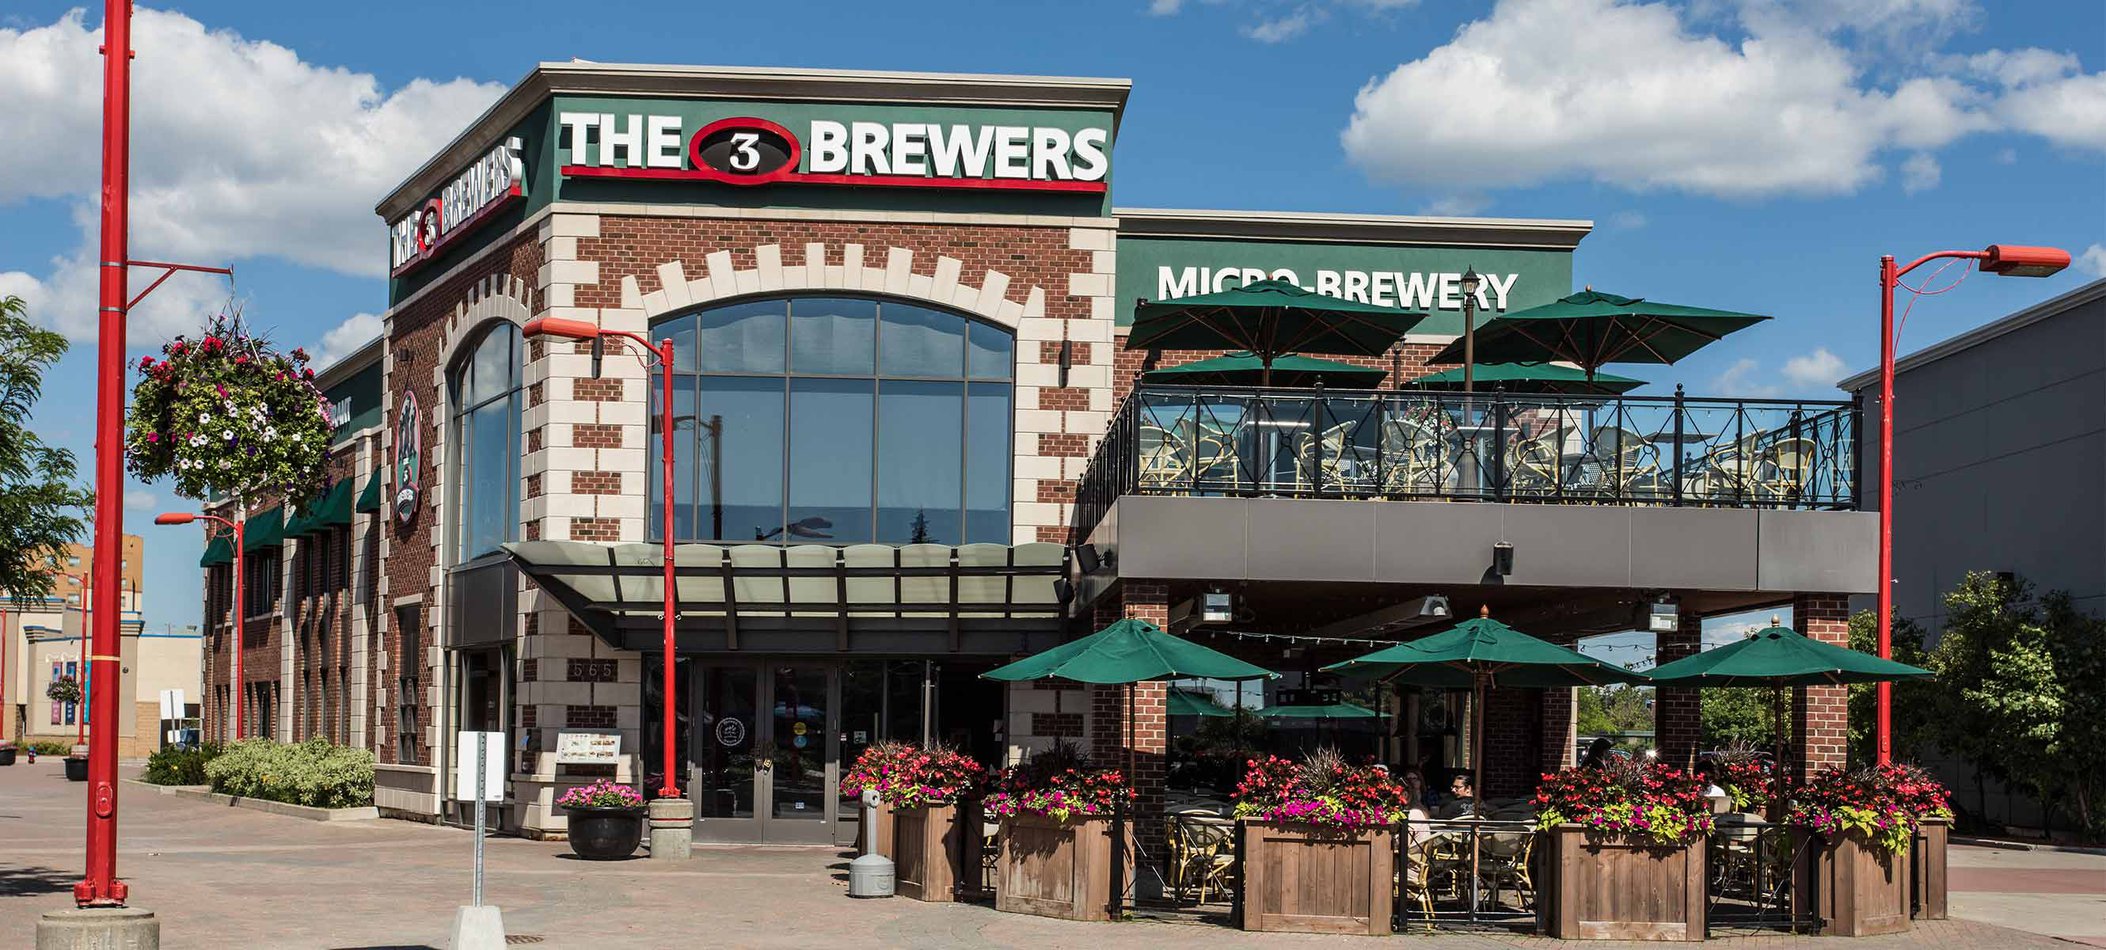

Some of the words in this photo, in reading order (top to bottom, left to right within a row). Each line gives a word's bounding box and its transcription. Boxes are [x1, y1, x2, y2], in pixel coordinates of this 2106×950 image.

[560, 112, 682, 168] THE
[729, 132, 760, 171] 3
[810, 119, 1108, 181] BREWERS
[391, 210, 422, 269] THE
[424, 211, 438, 246] 3
[441, 136, 523, 236] BREWERS
[573, 663, 612, 677] 565
